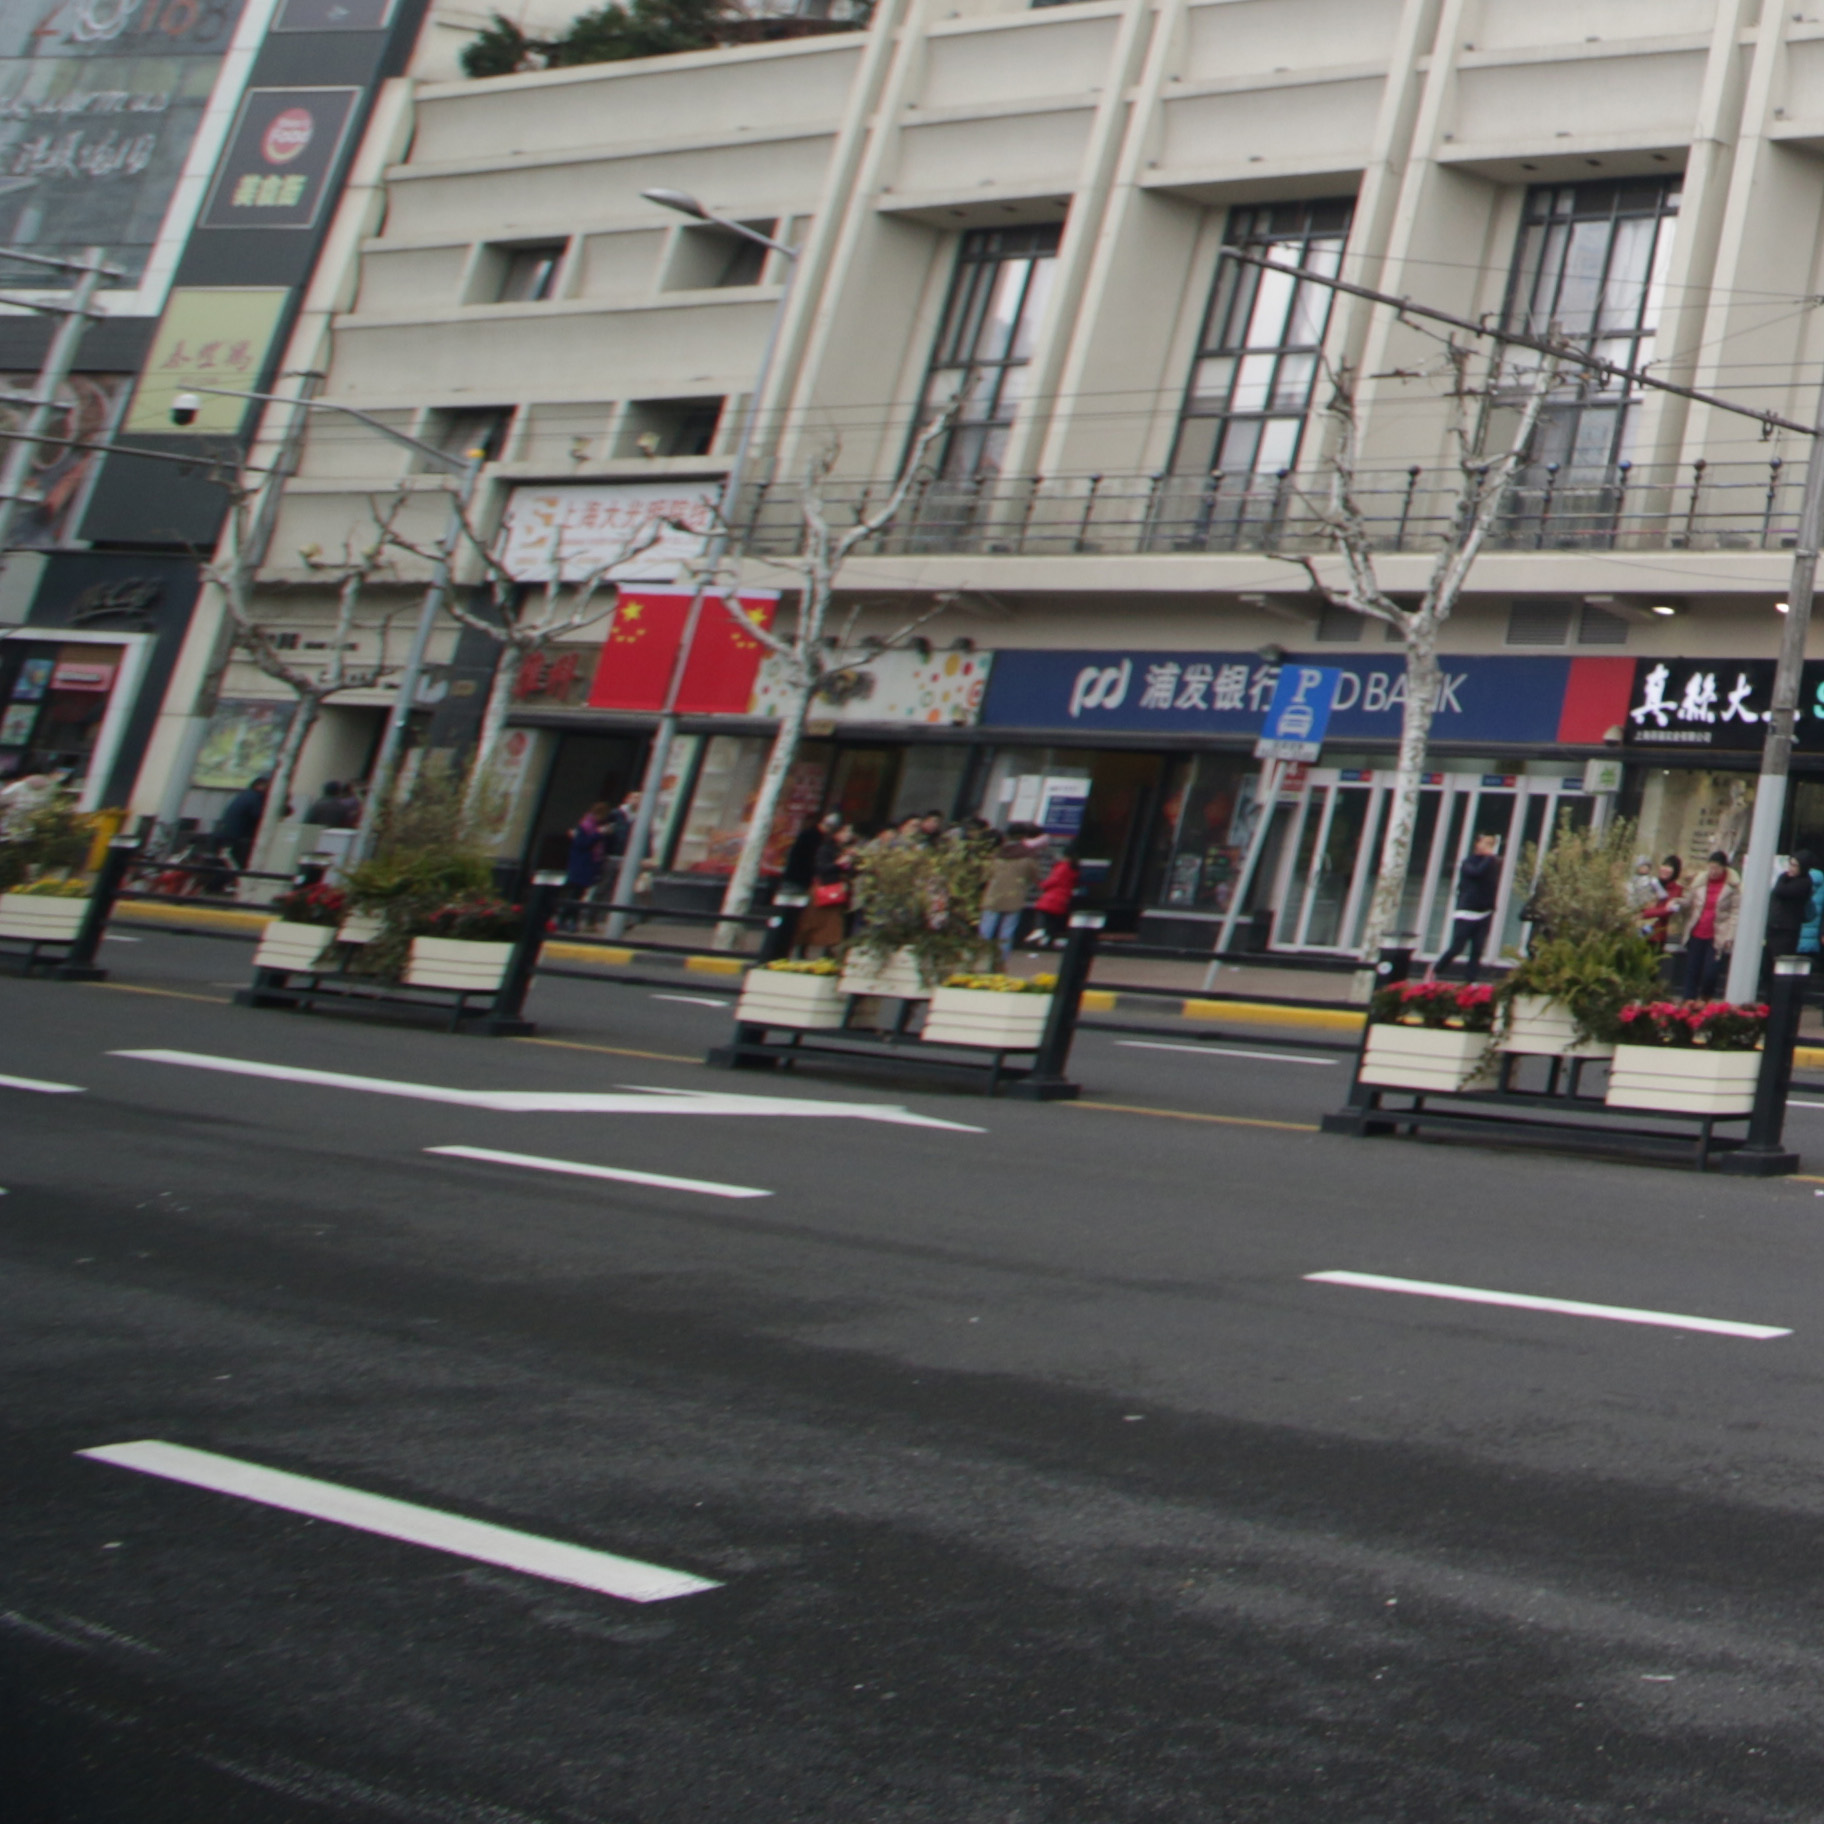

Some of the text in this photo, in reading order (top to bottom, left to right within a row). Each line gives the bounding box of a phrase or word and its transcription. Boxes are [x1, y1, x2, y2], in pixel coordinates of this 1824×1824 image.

[1140, 663, 1278, 712] 浦发银行
[1291, 667, 1323, 704] P
